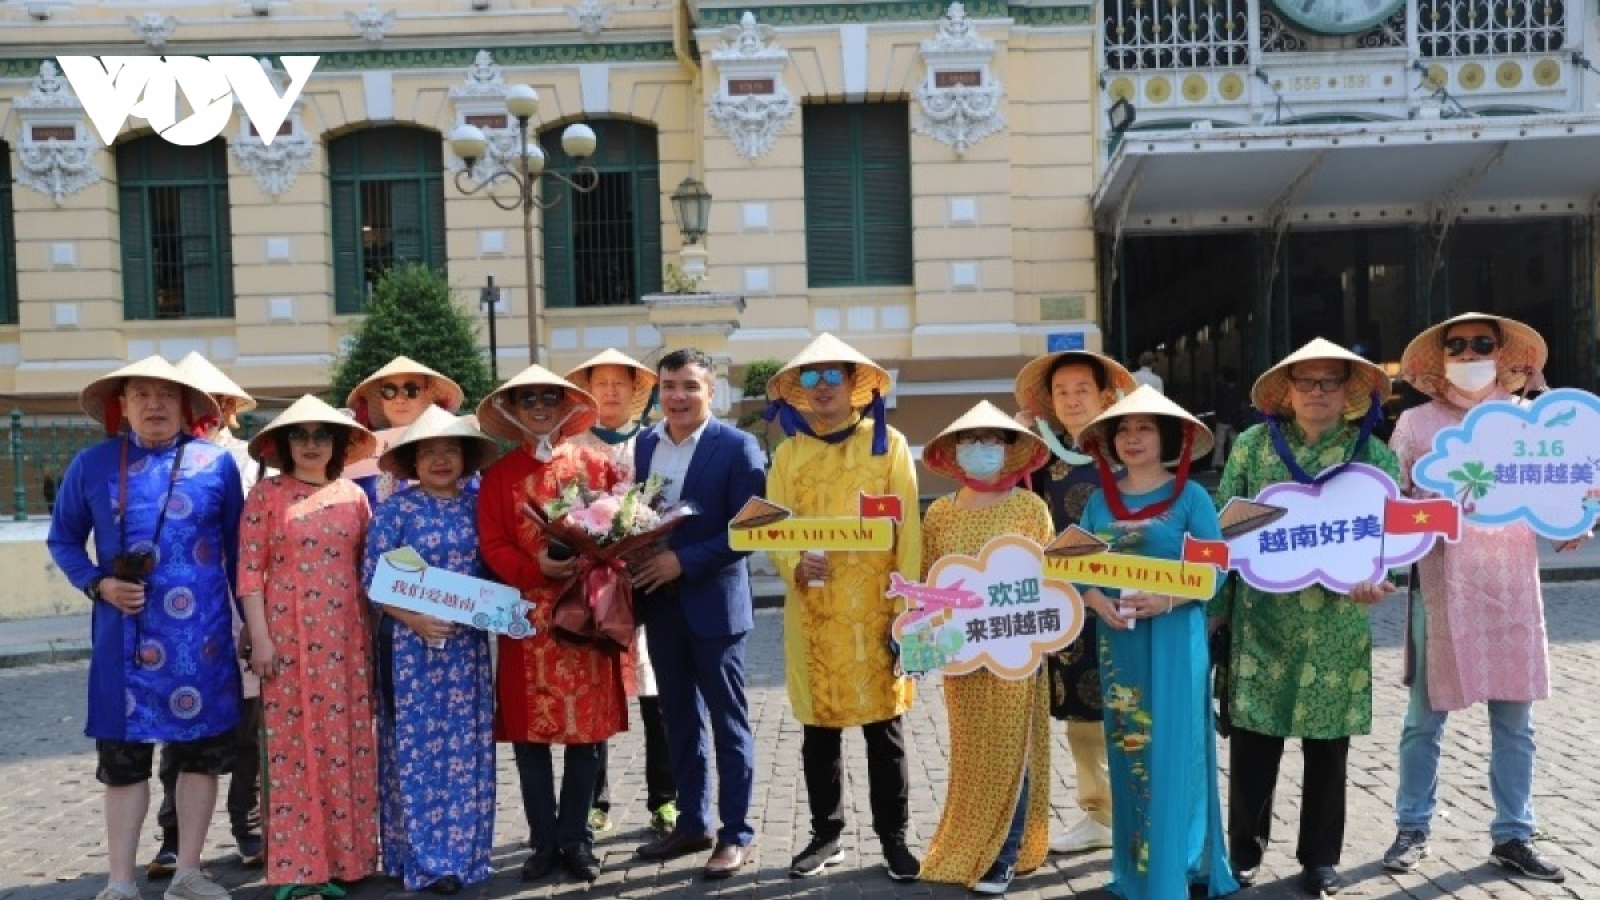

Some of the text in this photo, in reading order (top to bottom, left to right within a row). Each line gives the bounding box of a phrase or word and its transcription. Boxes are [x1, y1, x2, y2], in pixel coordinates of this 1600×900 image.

[1513, 439, 1565, 457] 3.16
[1494, 462, 1594, 485] 越南越美
[802, 528, 873, 541] VIETNAM
[1258, 514, 1382, 555] 越南好美
[1127, 567, 1203, 588] VIETNAM
[391, 579, 476, 613] 我们爱越南
[987, 577, 1041, 607] 欢迎
[965, 607, 1061, 644] 来到越南
